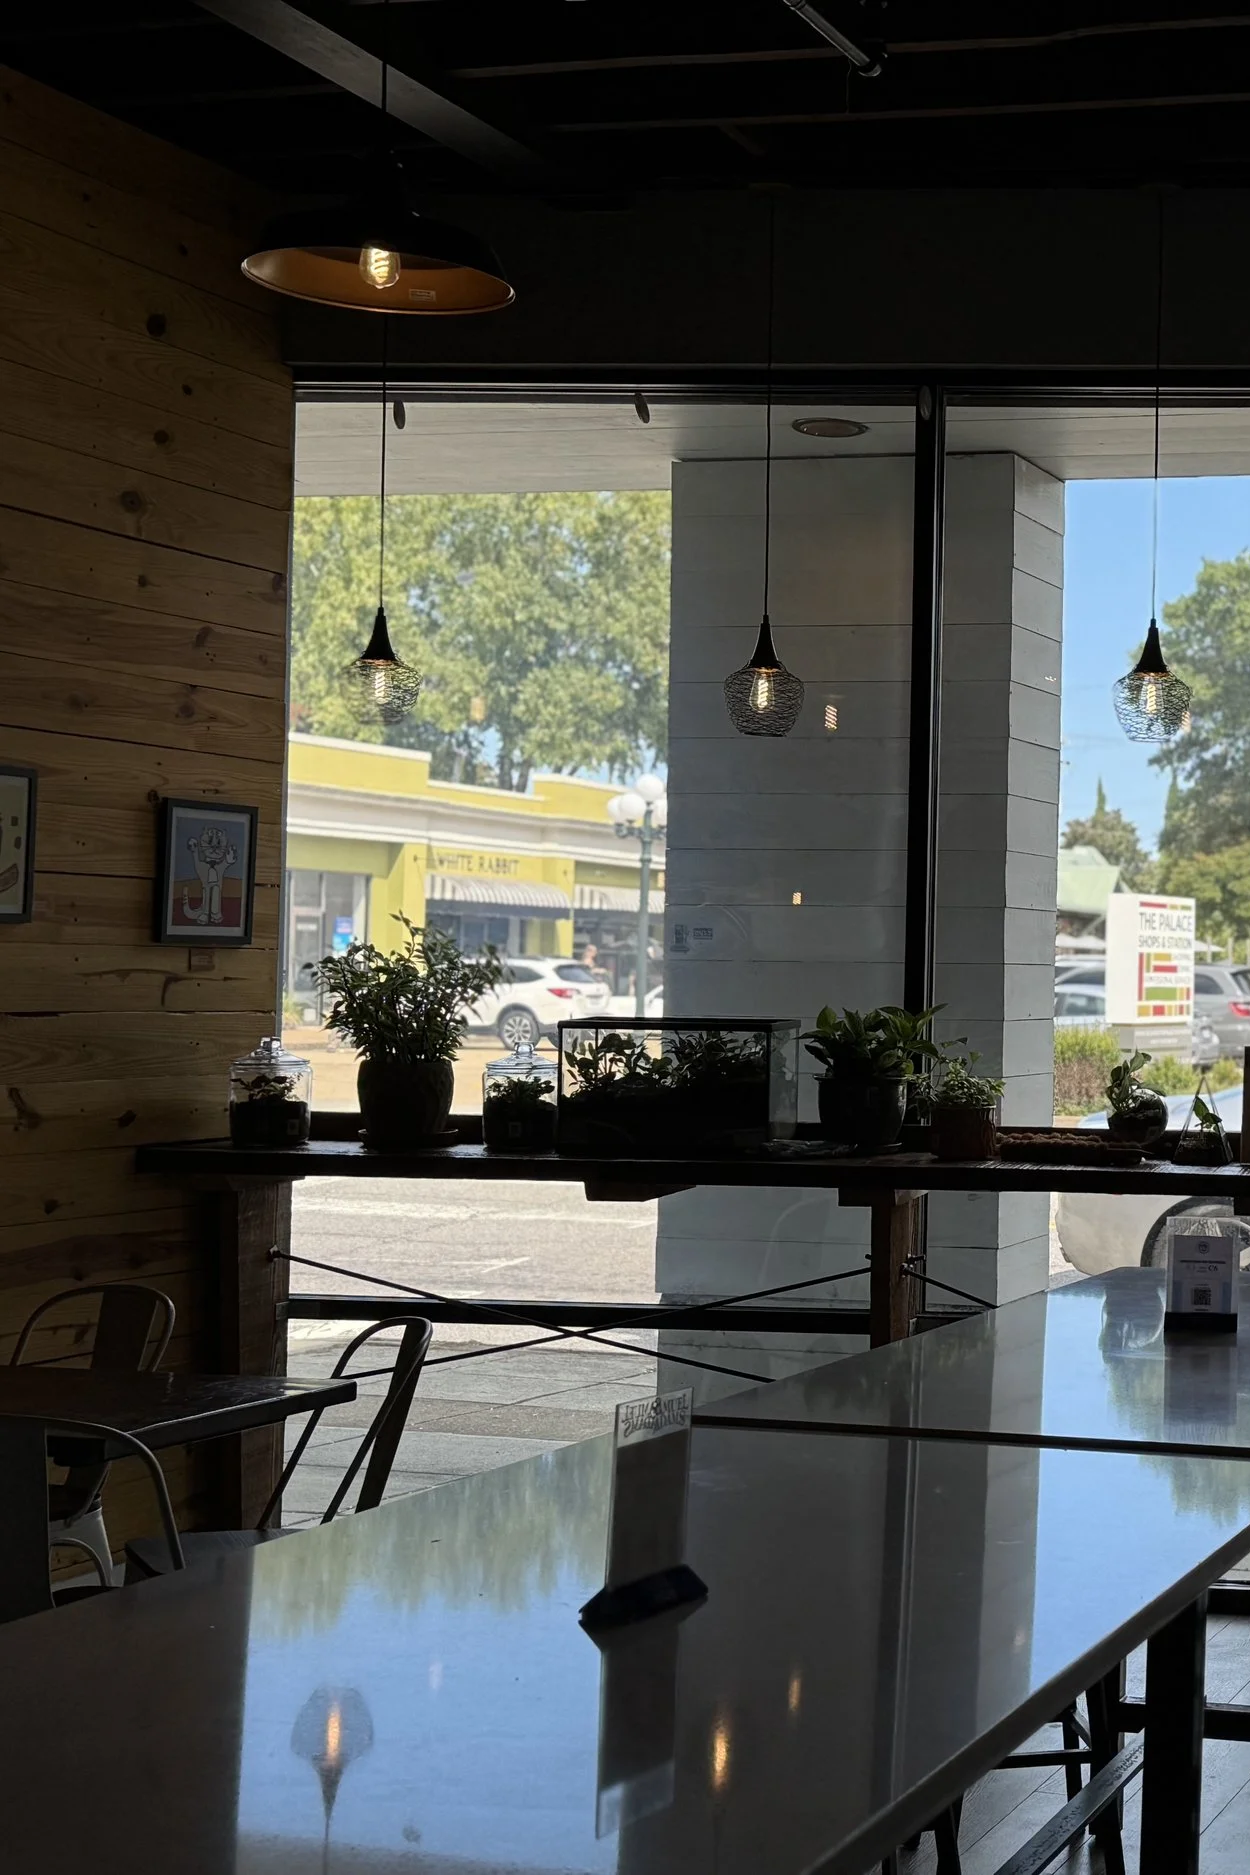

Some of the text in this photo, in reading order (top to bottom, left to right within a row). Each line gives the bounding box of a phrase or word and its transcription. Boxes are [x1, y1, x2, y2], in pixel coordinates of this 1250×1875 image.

[437, 852, 519, 876] WHITE RABBIT
[1139, 912, 1192, 932] THE PALACE
[1138, 936, 1160, 949] SHOPS
[1167, 937, 1192, 949] STATION
